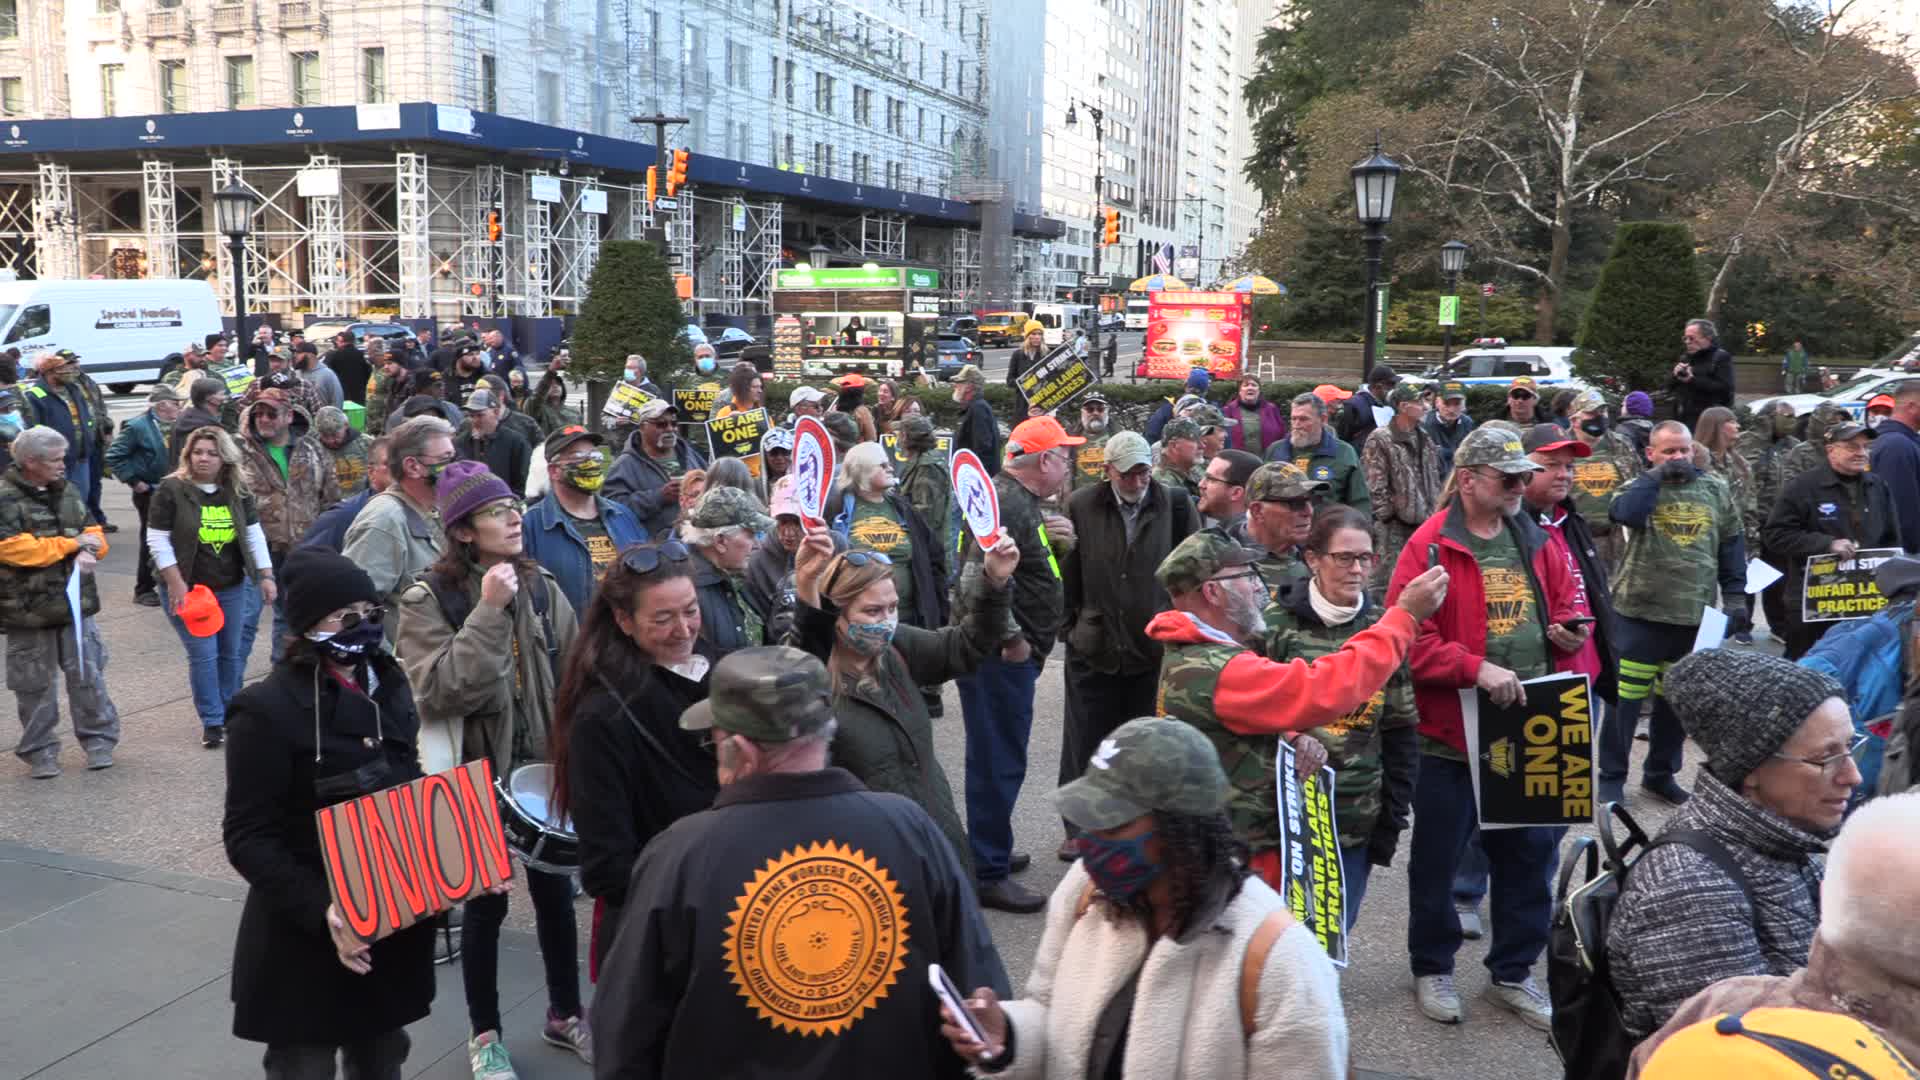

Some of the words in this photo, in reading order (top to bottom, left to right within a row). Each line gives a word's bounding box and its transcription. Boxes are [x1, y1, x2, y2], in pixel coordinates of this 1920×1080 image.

[101, 307, 137, 320] Special
[140, 306, 181, 320] Handling
[1035, 366, 1049, 380] ON
[1046, 348, 1075, 371] STRIKE
[1055, 362, 1084, 386] LABOR
[676, 391, 697, 400] WE
[698, 391, 721, 400] ARE
[684, 401, 712, 411] ONE
[1040, 375, 1086, 410] PRACTICES
[709, 417, 735, 433] WE
[737, 409, 765, 426] ARE
[722, 425, 760, 444] ONE
[1807, 583, 1856, 599] UNFAIR
[1560, 684, 1589, 745] WE
[1523, 714, 1560, 797] ONE
[1284, 751, 1302, 836] STRIKE
[1562, 753, 1592, 818] ARE
[1303, 773, 1325, 847] LABO
[318, 758, 512, 941] UNION
[1291, 840, 1304, 876] ON
[1317, 792, 1341, 934] PRACTICES
[743, 908, 765, 950] UNITED
[761, 878, 789, 906] MINE
[787, 864, 847, 883] WORKERS
[849, 871, 866, 886] OF
[862, 883, 893, 932] AMERICA
[750, 968, 802, 1016] ORGANIZED
[804, 996, 857, 1017] JANUARY
[868, 950, 889, 977] 1890
